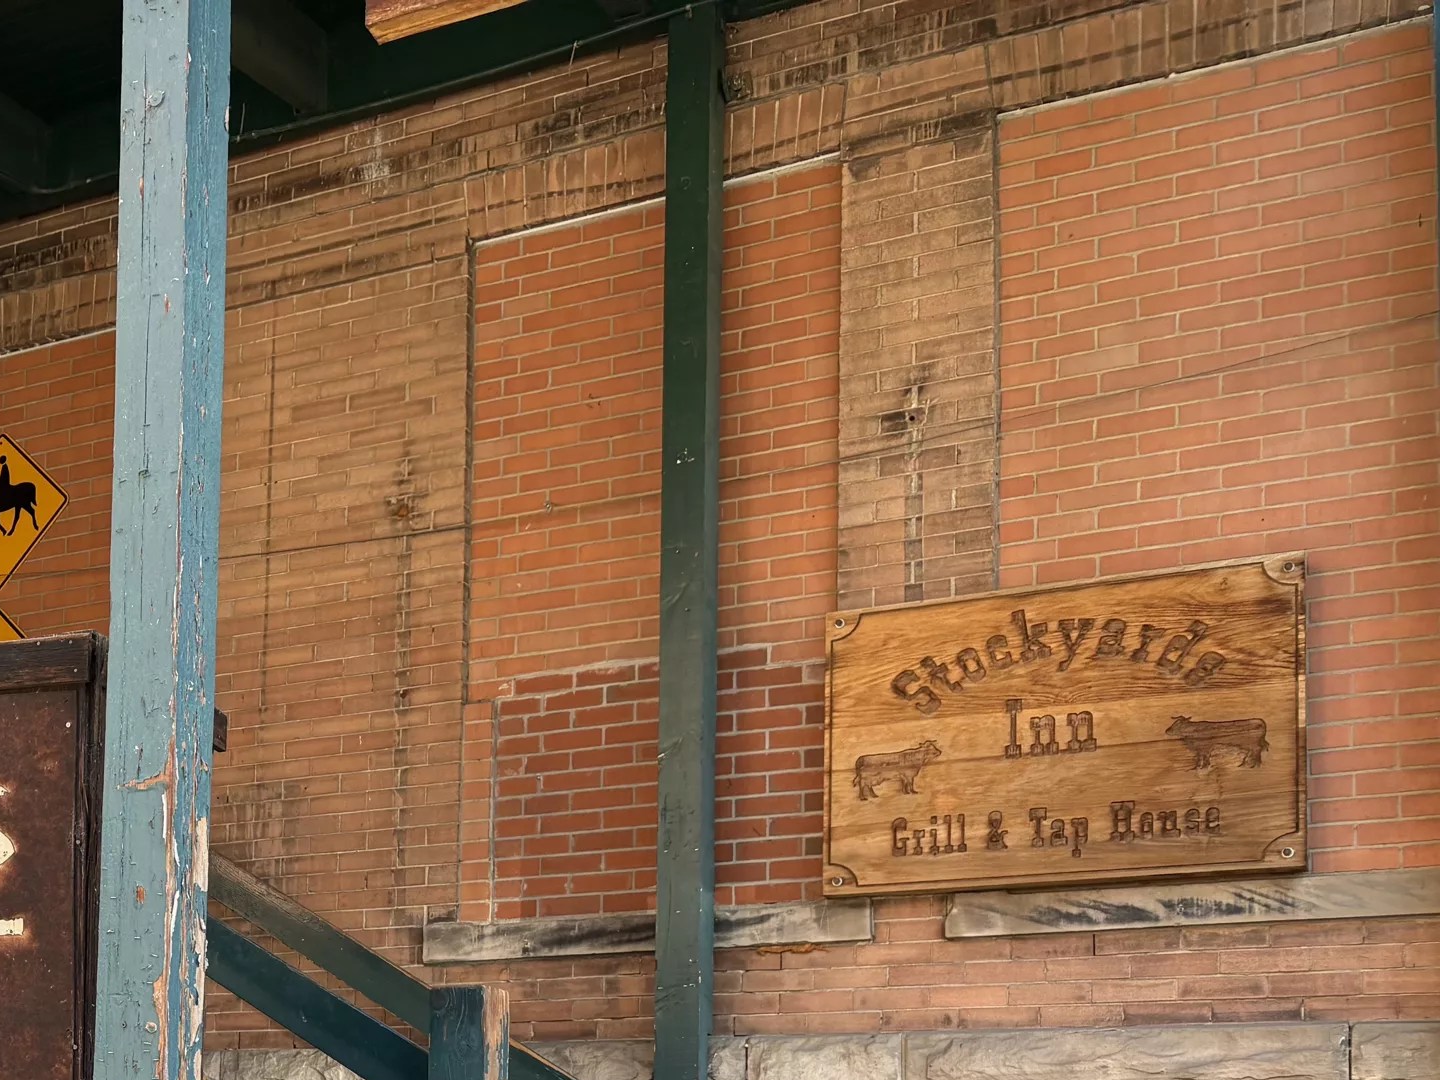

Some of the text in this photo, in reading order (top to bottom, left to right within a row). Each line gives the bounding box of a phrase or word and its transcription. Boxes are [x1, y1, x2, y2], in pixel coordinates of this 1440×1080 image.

[890, 608, 1229, 716] Stockyards
[1003, 699, 1099, 760] Inn
[891, 800, 1222, 858] Grill & Tap House
